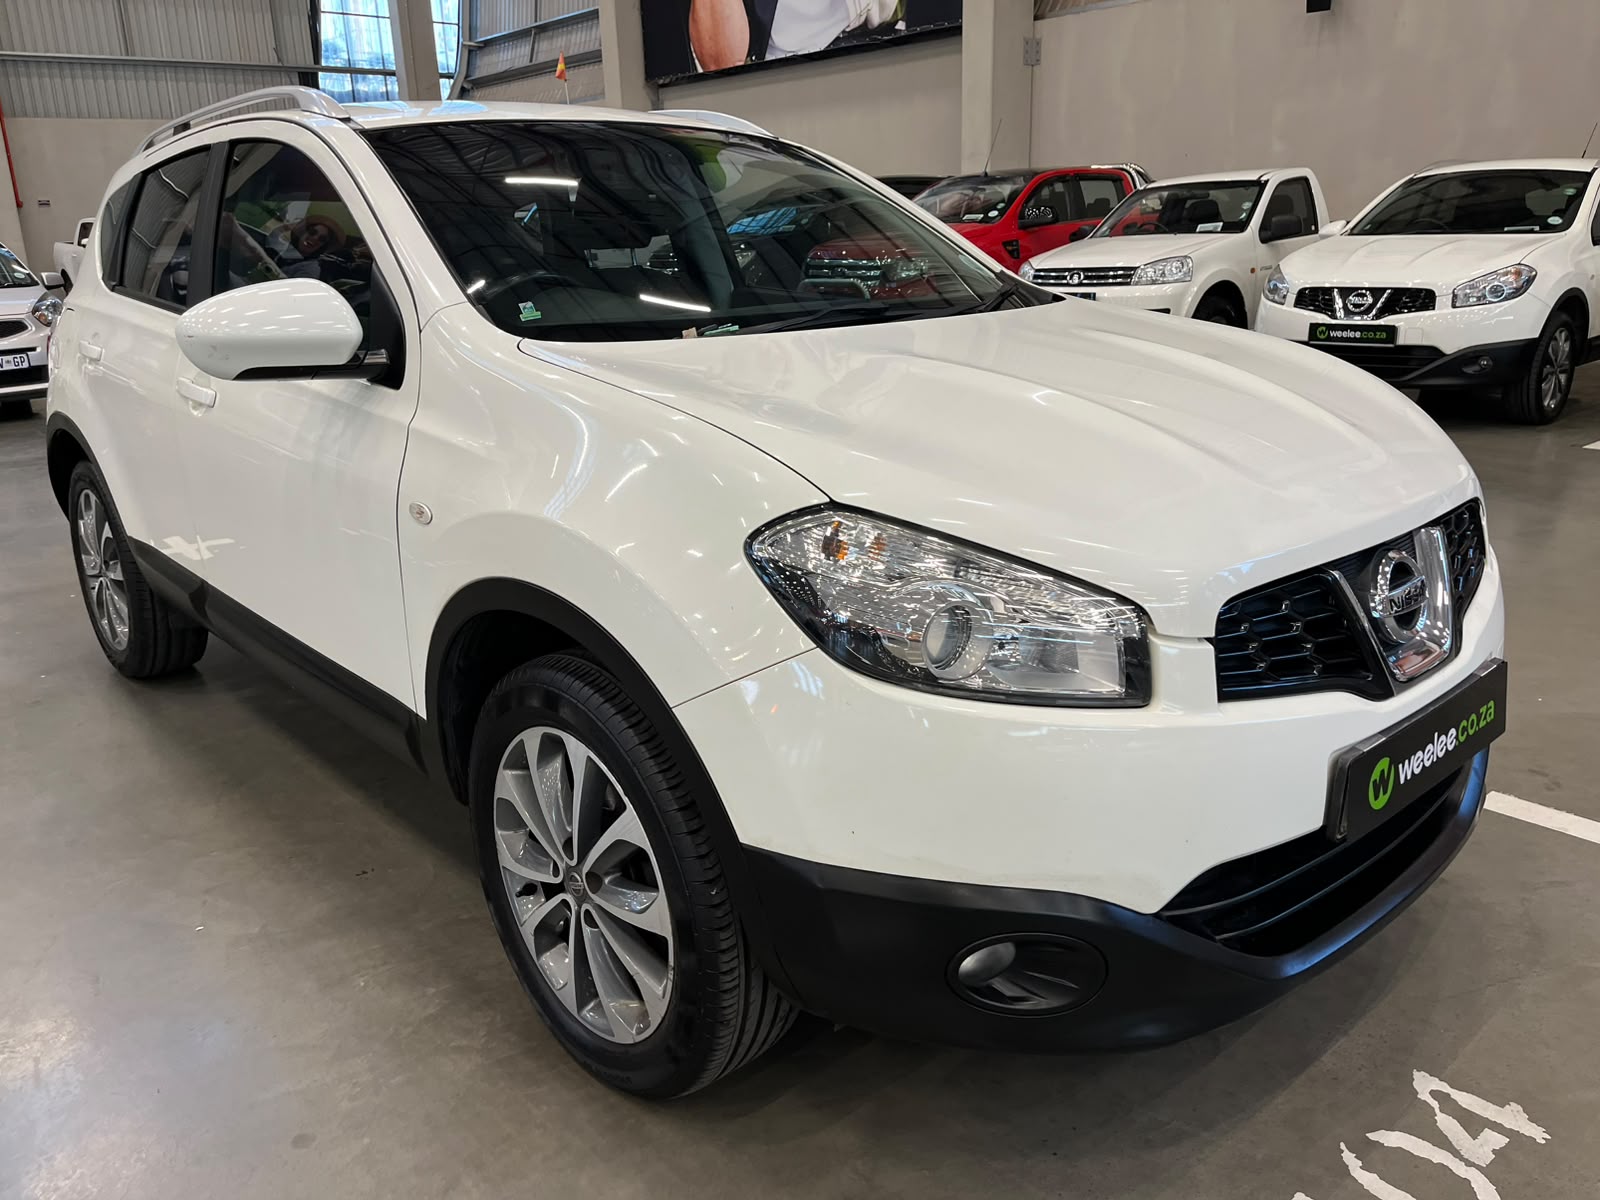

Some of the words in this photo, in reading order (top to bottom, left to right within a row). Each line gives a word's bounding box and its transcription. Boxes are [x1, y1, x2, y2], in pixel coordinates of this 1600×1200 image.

[1329, 327, 1387, 339] weelee.co.za
[12, 355, 26, 368] GP
[1398, 700, 1496, 785] weelee.co.za
